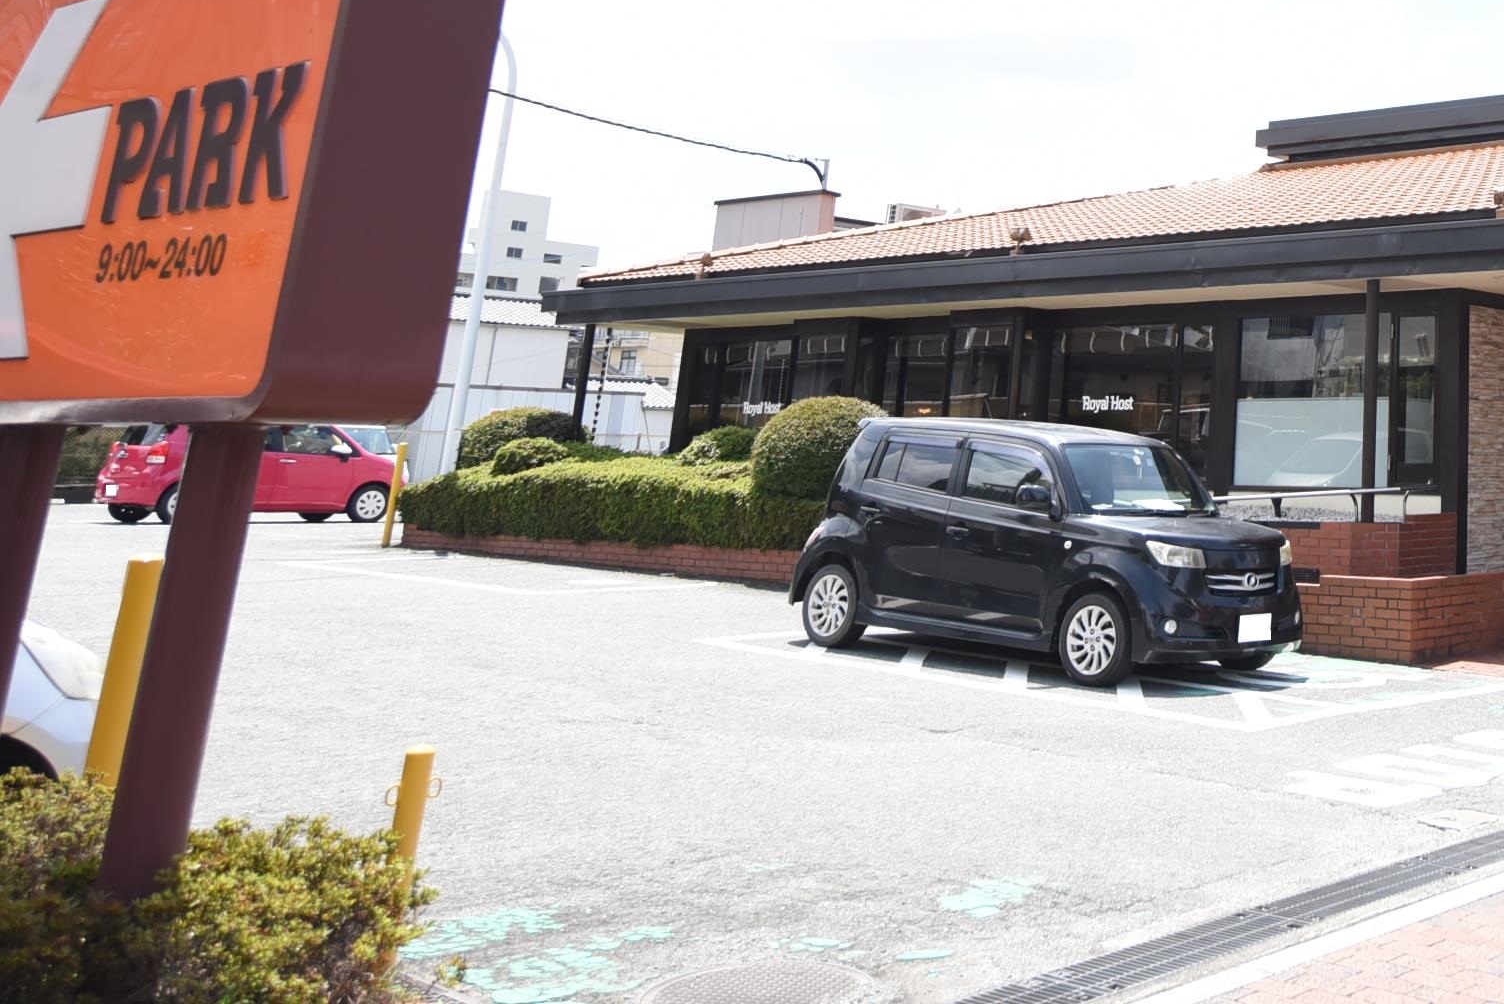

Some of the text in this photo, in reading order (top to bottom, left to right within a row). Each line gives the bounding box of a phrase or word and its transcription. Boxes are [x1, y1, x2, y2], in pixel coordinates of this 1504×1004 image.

[101, 61, 311, 224] PARK
[743, 401, 763, 416] Royal
[1082, 395, 1134, 413] Royal Host
